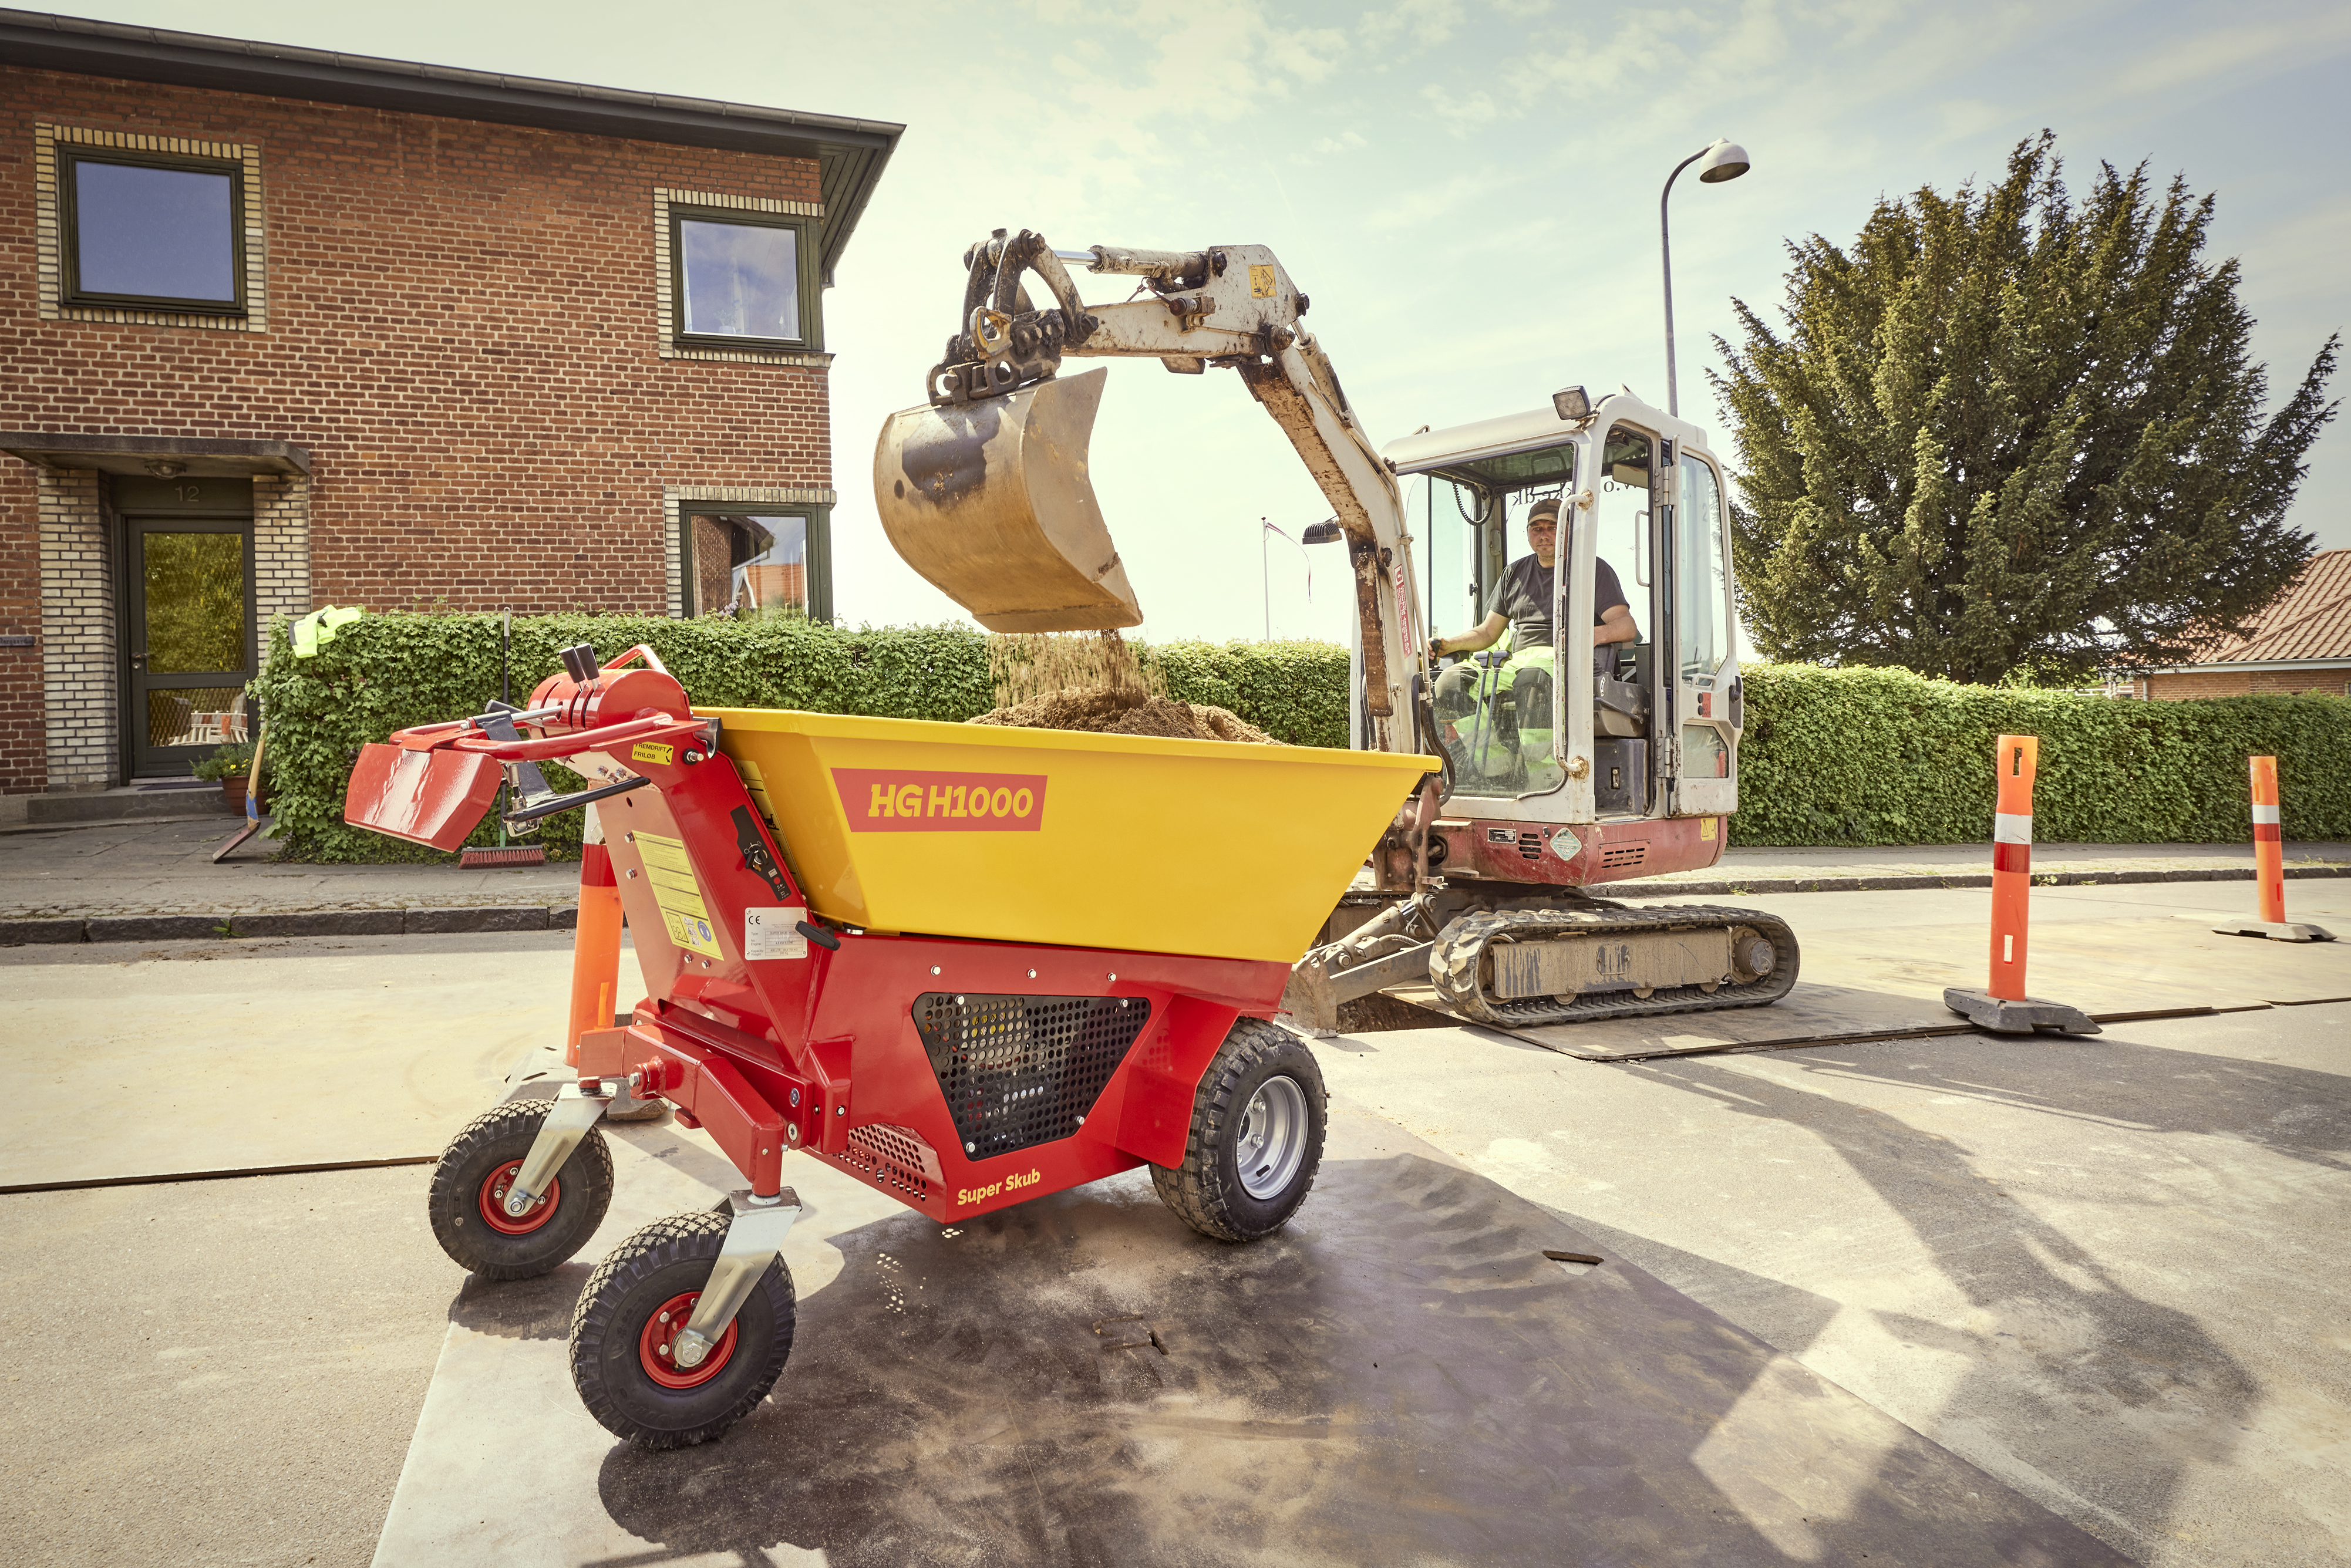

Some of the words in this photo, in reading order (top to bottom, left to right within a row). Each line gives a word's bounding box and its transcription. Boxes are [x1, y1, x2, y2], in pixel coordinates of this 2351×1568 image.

[175, 485, 200, 502] 12
[635, 743, 666, 752] FREMDRIFT
[634, 751, 655, 759] FRILØB
[868, 784, 924, 817] HG
[927, 785, 1033, 818] H1000
[749, 916, 760, 925] CE
[957, 1181, 1002, 1205] Super
[1005, 1168, 1040, 1191] Skub
